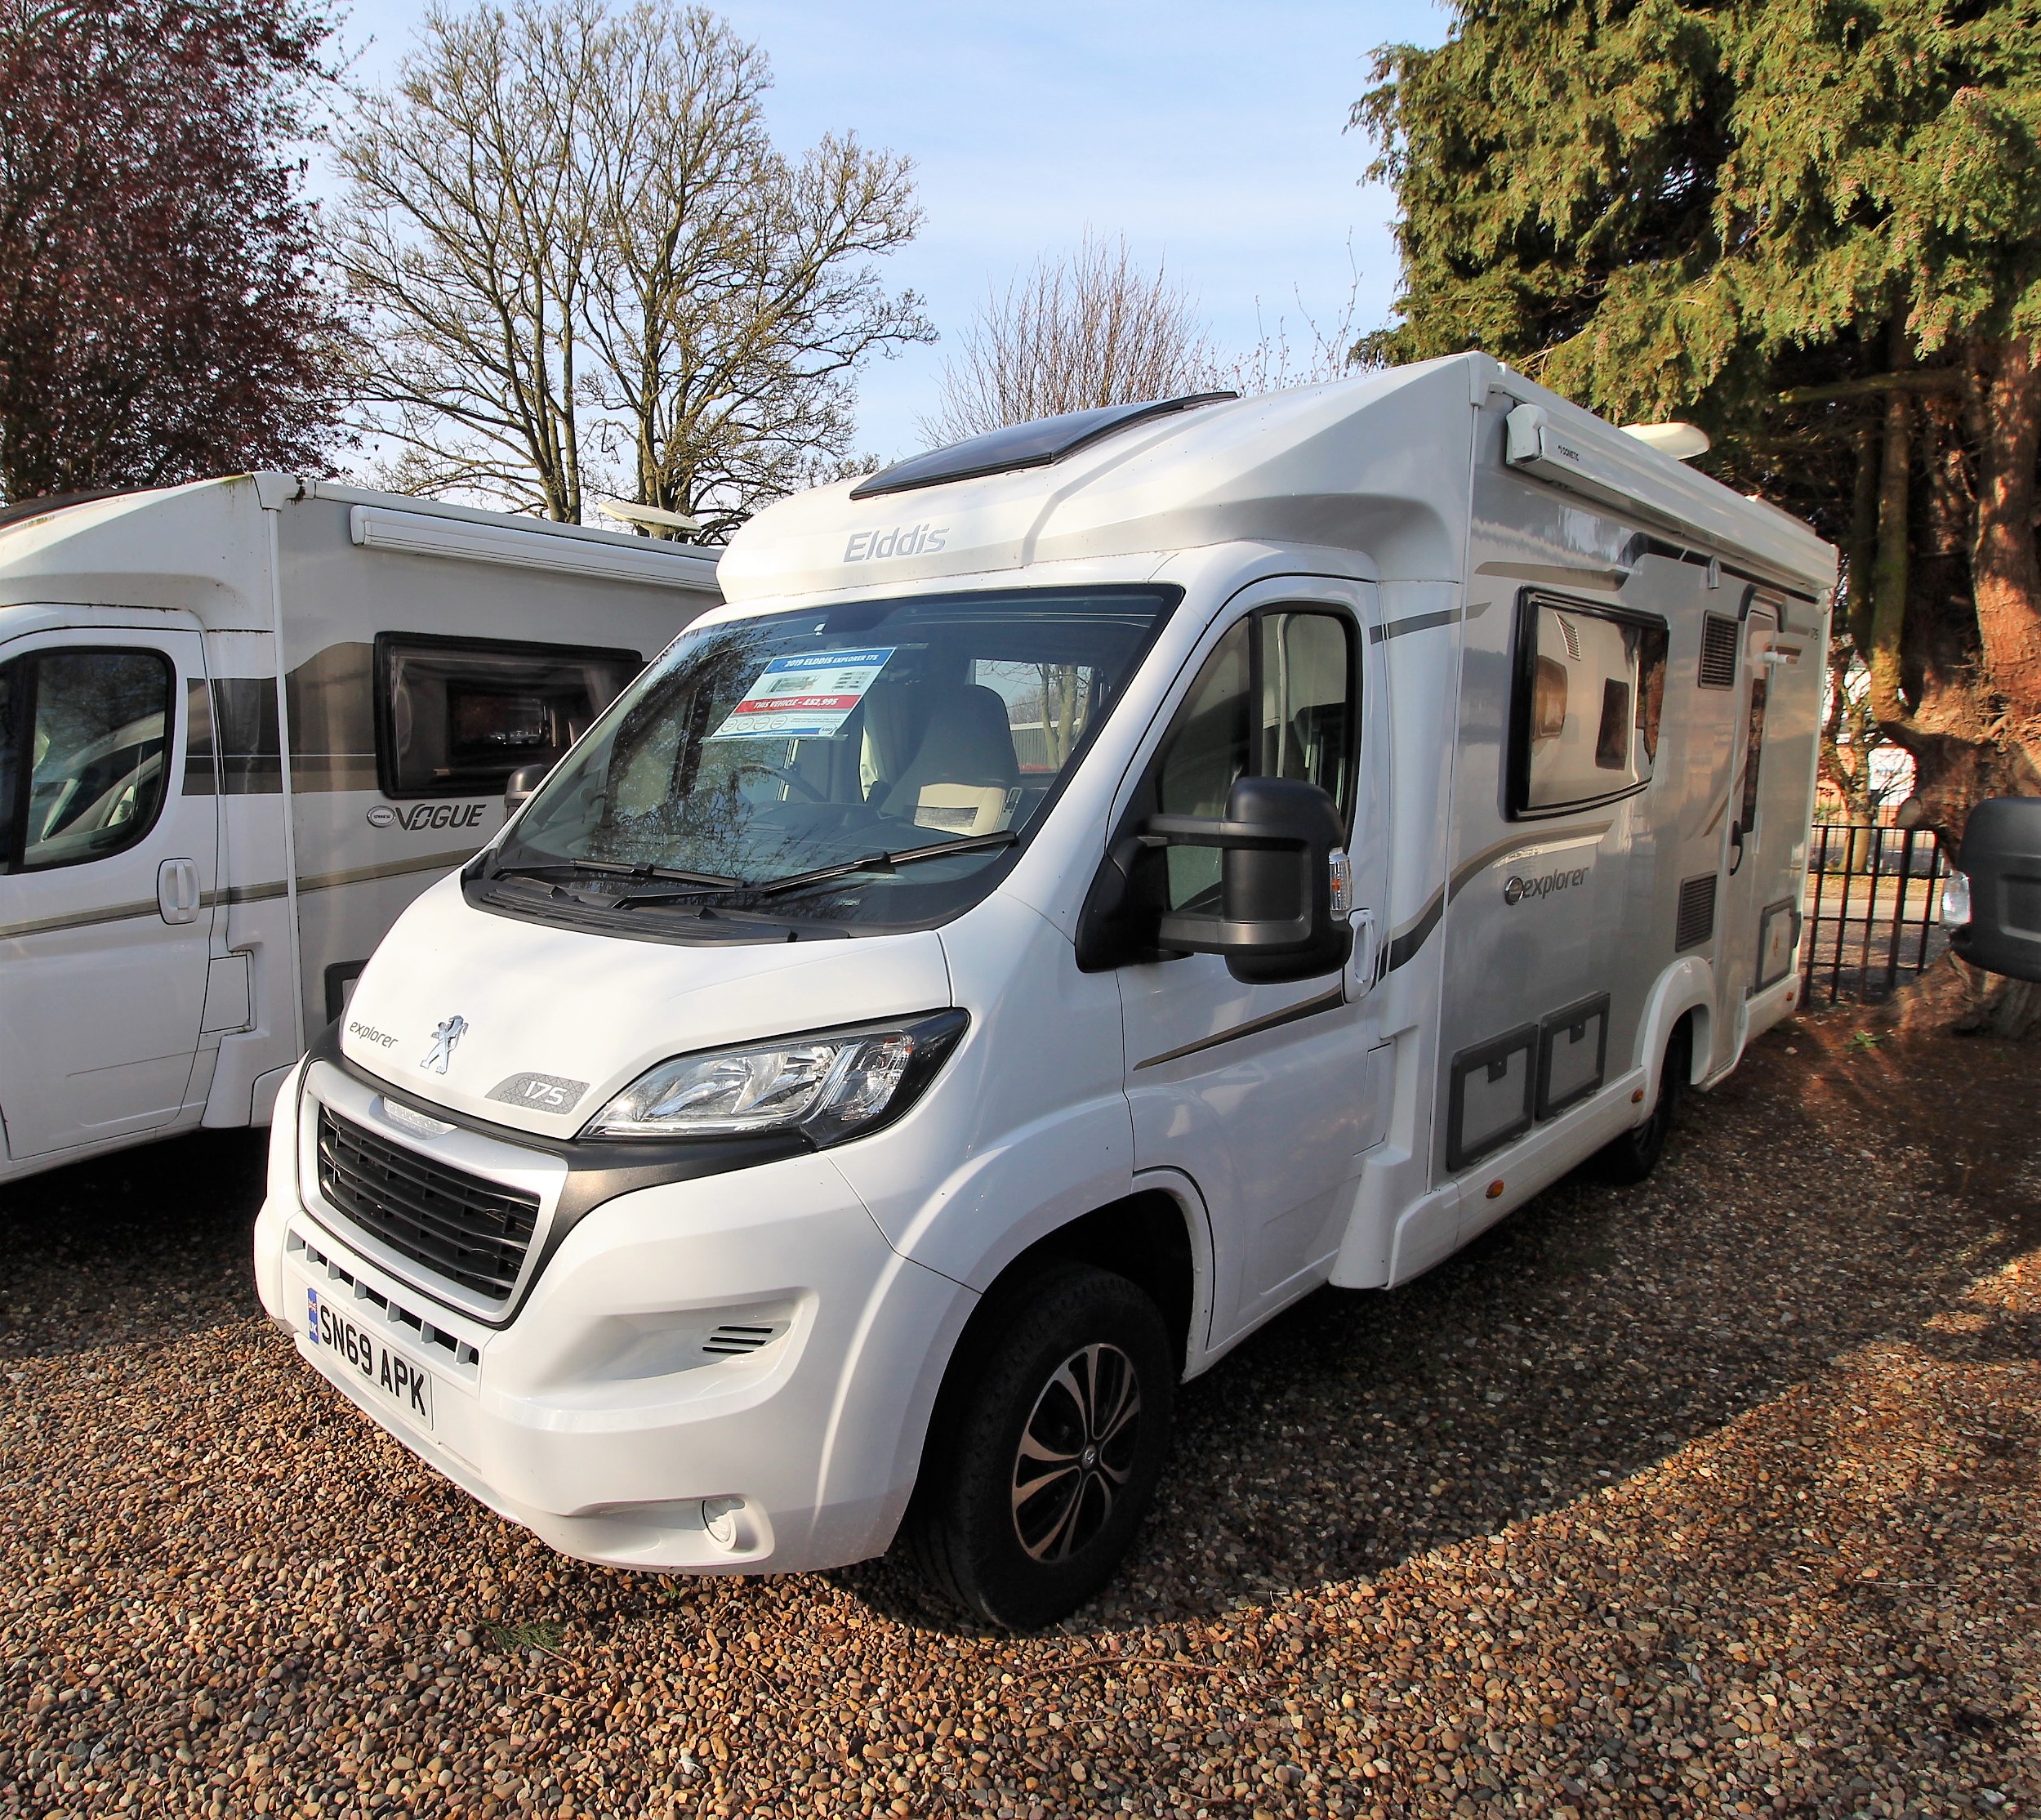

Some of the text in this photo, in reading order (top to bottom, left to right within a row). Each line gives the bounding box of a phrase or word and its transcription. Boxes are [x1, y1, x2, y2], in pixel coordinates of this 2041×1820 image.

[844, 524, 950, 563] Elddis
[784, 659, 804, 667] 2019
[803, 657, 834, 666] ELDDIS
[831, 655, 867, 663] EXPLORER
[753, 701, 771, 709] THIS
[769, 698, 800, 707] VEHICLE
[395, 804, 487, 832] VOGUE
[1522, 867, 1590, 899] explorer
[350, 1022, 399, 1049] explorer
[524, 1081, 568, 1105] 175
[309, 1322, 318, 1336] UK
[320, 1305, 426, 1417] SN69 APK
